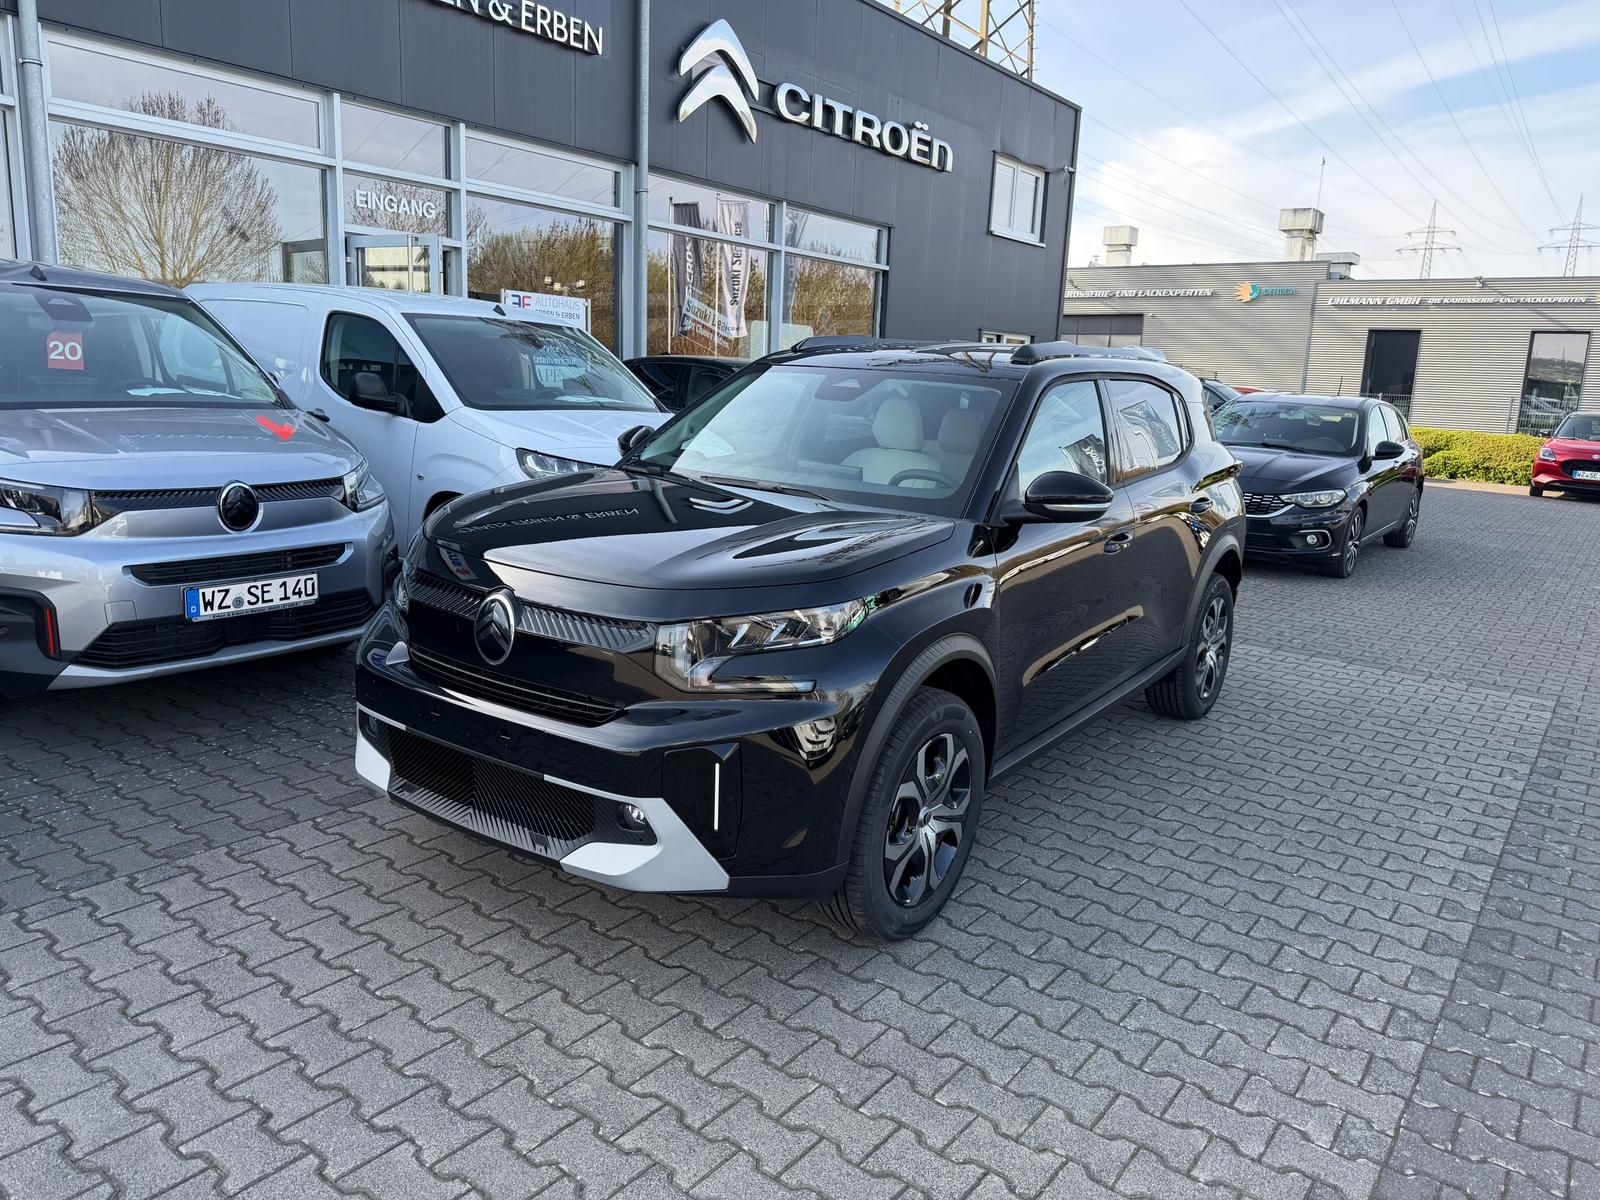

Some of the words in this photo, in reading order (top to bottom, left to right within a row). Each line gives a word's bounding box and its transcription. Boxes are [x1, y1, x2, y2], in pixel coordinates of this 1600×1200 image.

[521, 0, 603, 55] ERBEN
[355, 189, 436, 219] EINGANG
[731, 221, 743, 266] Serce
[730, 269, 742, 306] Suzuki
[1116, 289, 1136, 298] UND
[1138, 288, 1213, 297] LACKEXPERTEN
[535, 296, 581, 311] AUTOHAUS
[686, 299, 711, 323] Suzuki
[1328, 296, 1384, 306] UHLMANN
[1385, 296, 1421, 305] GMBH
[562, 312, 581, 320] ERBEN
[48, 341, 82, 361] 20
[201, 588, 231, 612] WZ
[247, 583, 274, 606] SE
[279, 577, 316, 602] 140
